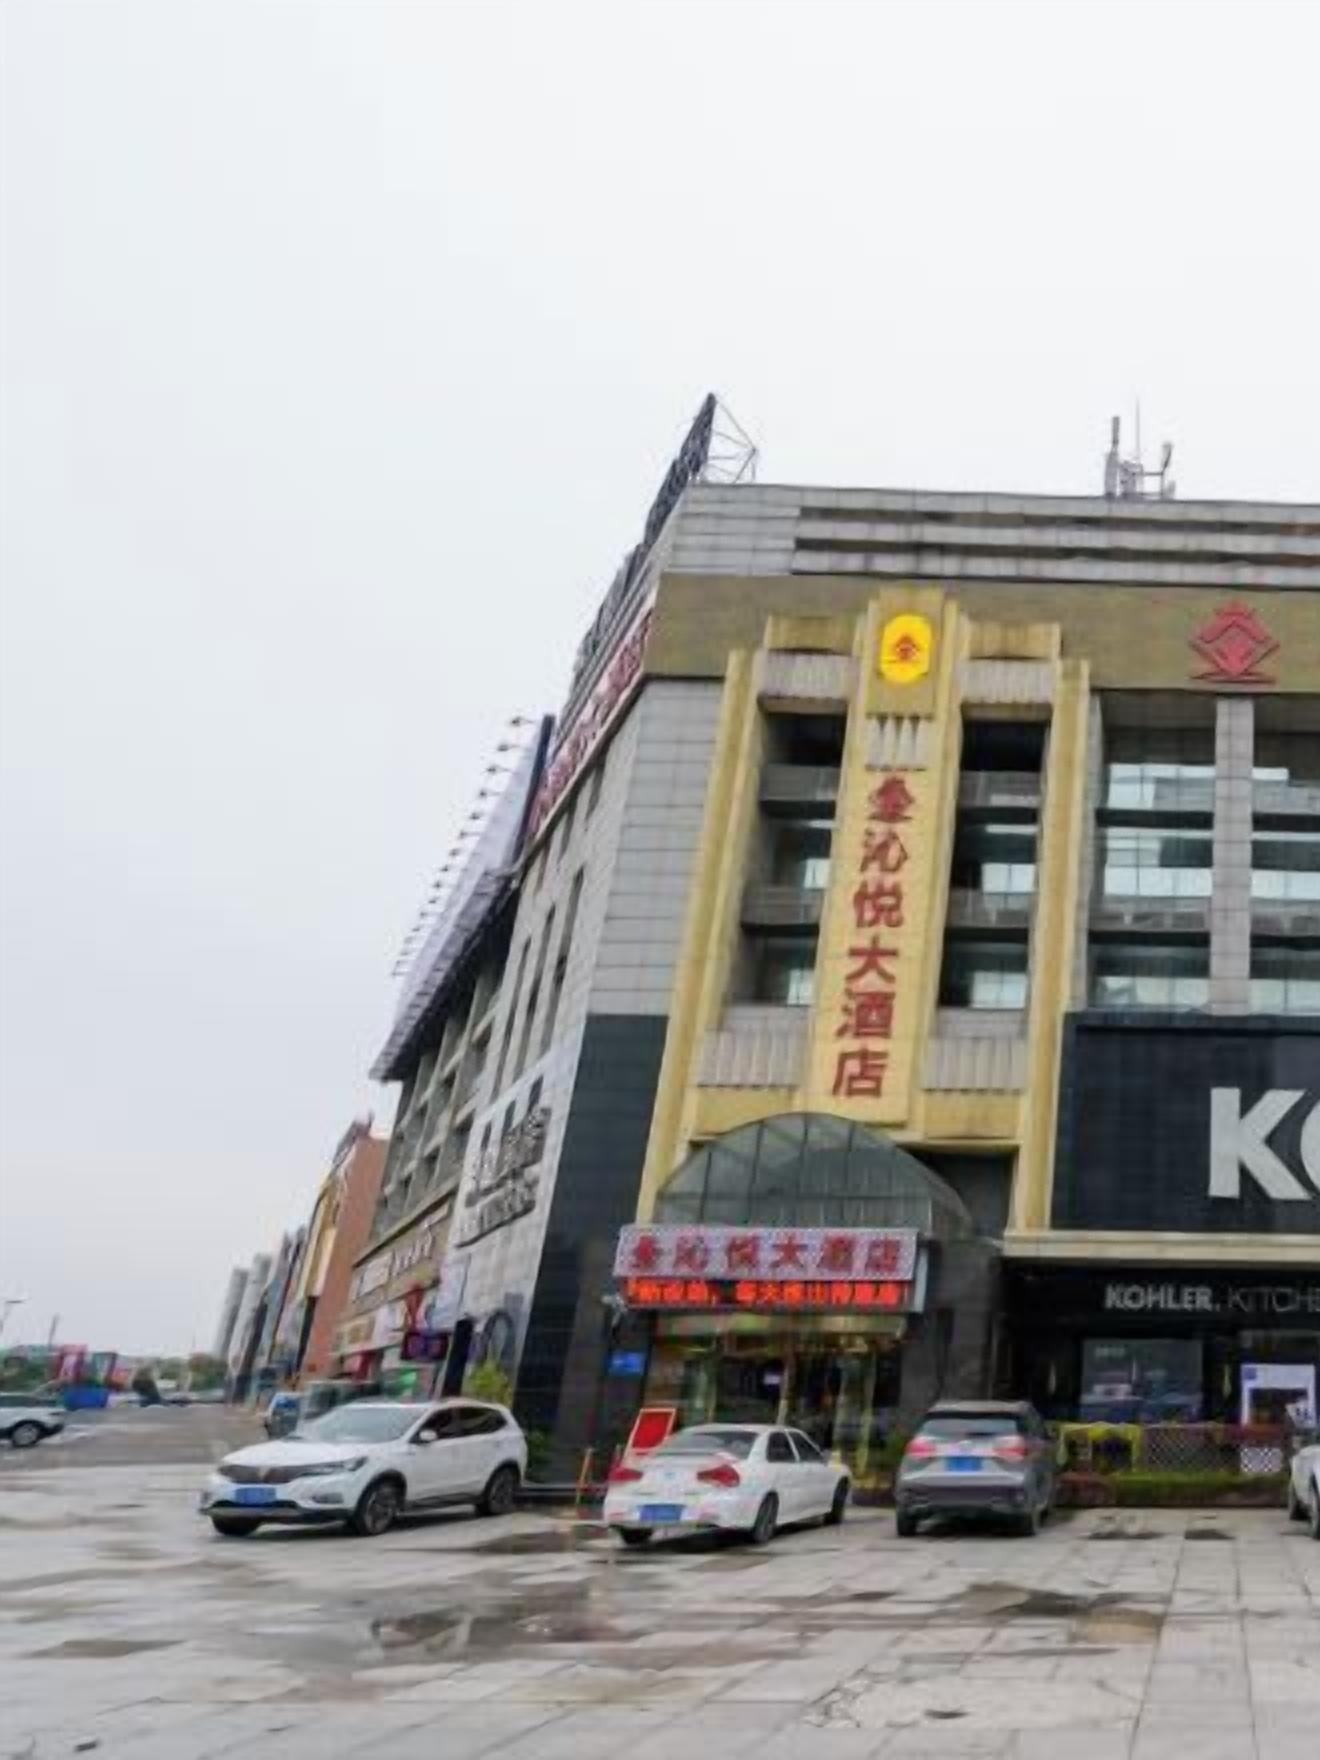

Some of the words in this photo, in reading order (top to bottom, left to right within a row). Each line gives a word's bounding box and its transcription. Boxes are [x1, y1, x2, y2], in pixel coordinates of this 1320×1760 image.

[832, 776, 916, 1097] 金沁悦大酒店
